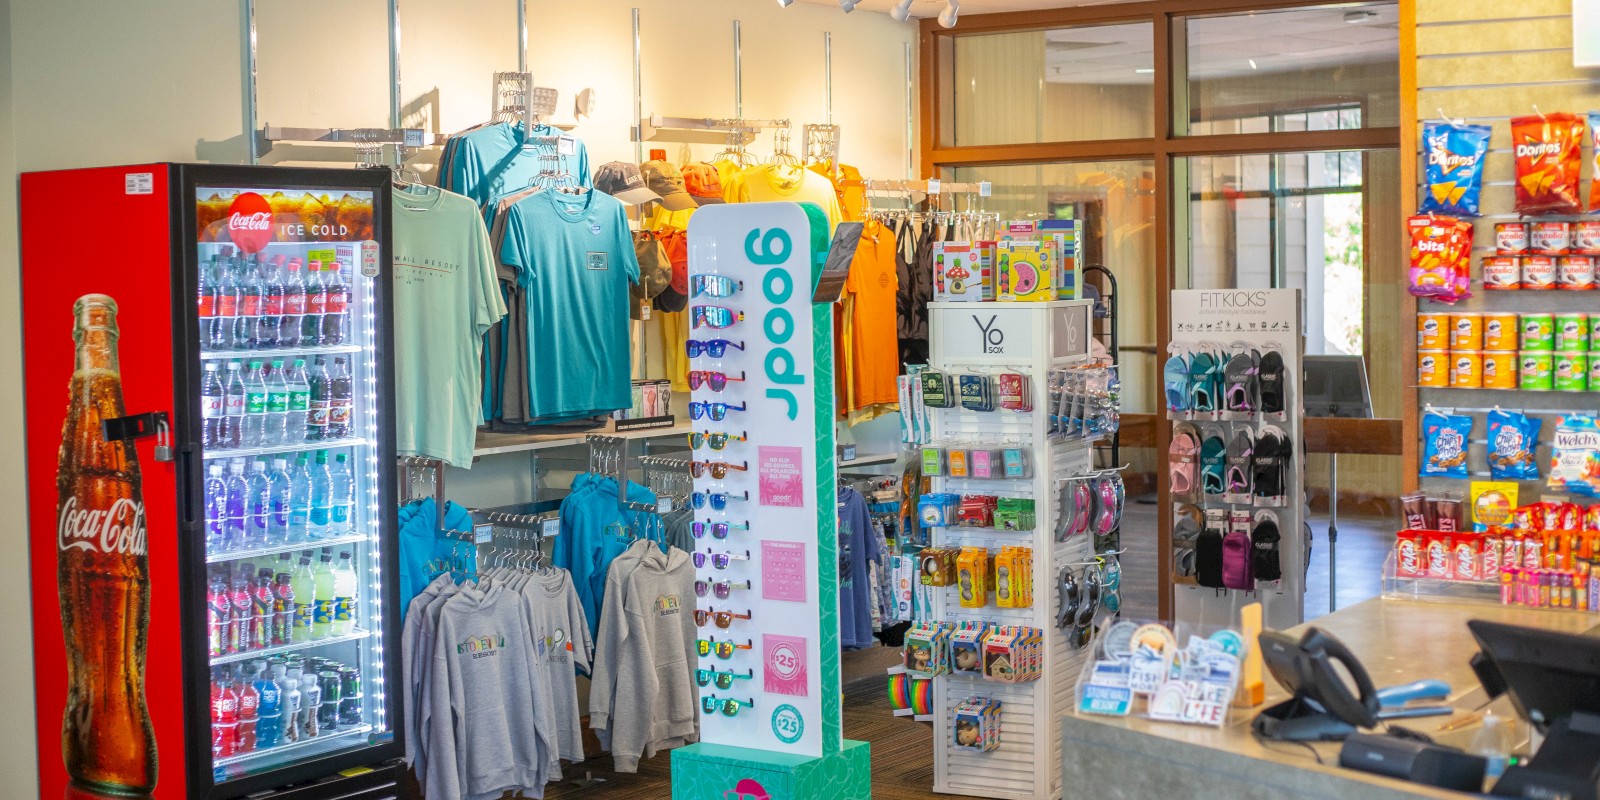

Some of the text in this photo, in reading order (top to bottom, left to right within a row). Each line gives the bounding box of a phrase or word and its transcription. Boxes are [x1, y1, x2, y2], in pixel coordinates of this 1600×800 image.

[1517, 142, 1560, 157] Doritos
[1429, 151, 1475, 166] Doritos
[229, 211, 272, 231] Coca-Cola
[281, 225, 348, 236] ICE COLD
[1498, 232, 1525, 240] nutella
[1538, 232, 1563, 240] nutella
[1418, 240, 1445, 252] bits
[1563, 267, 1590, 275] nutella
[1200, 291, 1267, 308] FITKICKS
[1217, 308, 1240, 317] lifestyle
[1240, 308, 1267, 316] footwear
[744, 227, 806, 422] goodr
[988, 346, 1004, 354] SOX
[1437, 434, 1458, 447] Chips
[1495, 434, 1516, 446] Chips
[1558, 433, 1598, 446] Welch's
[59, 496, 146, 556] Coca-Cola
[776, 654, 795, 669] $25
[778, 718, 797, 733] $25
